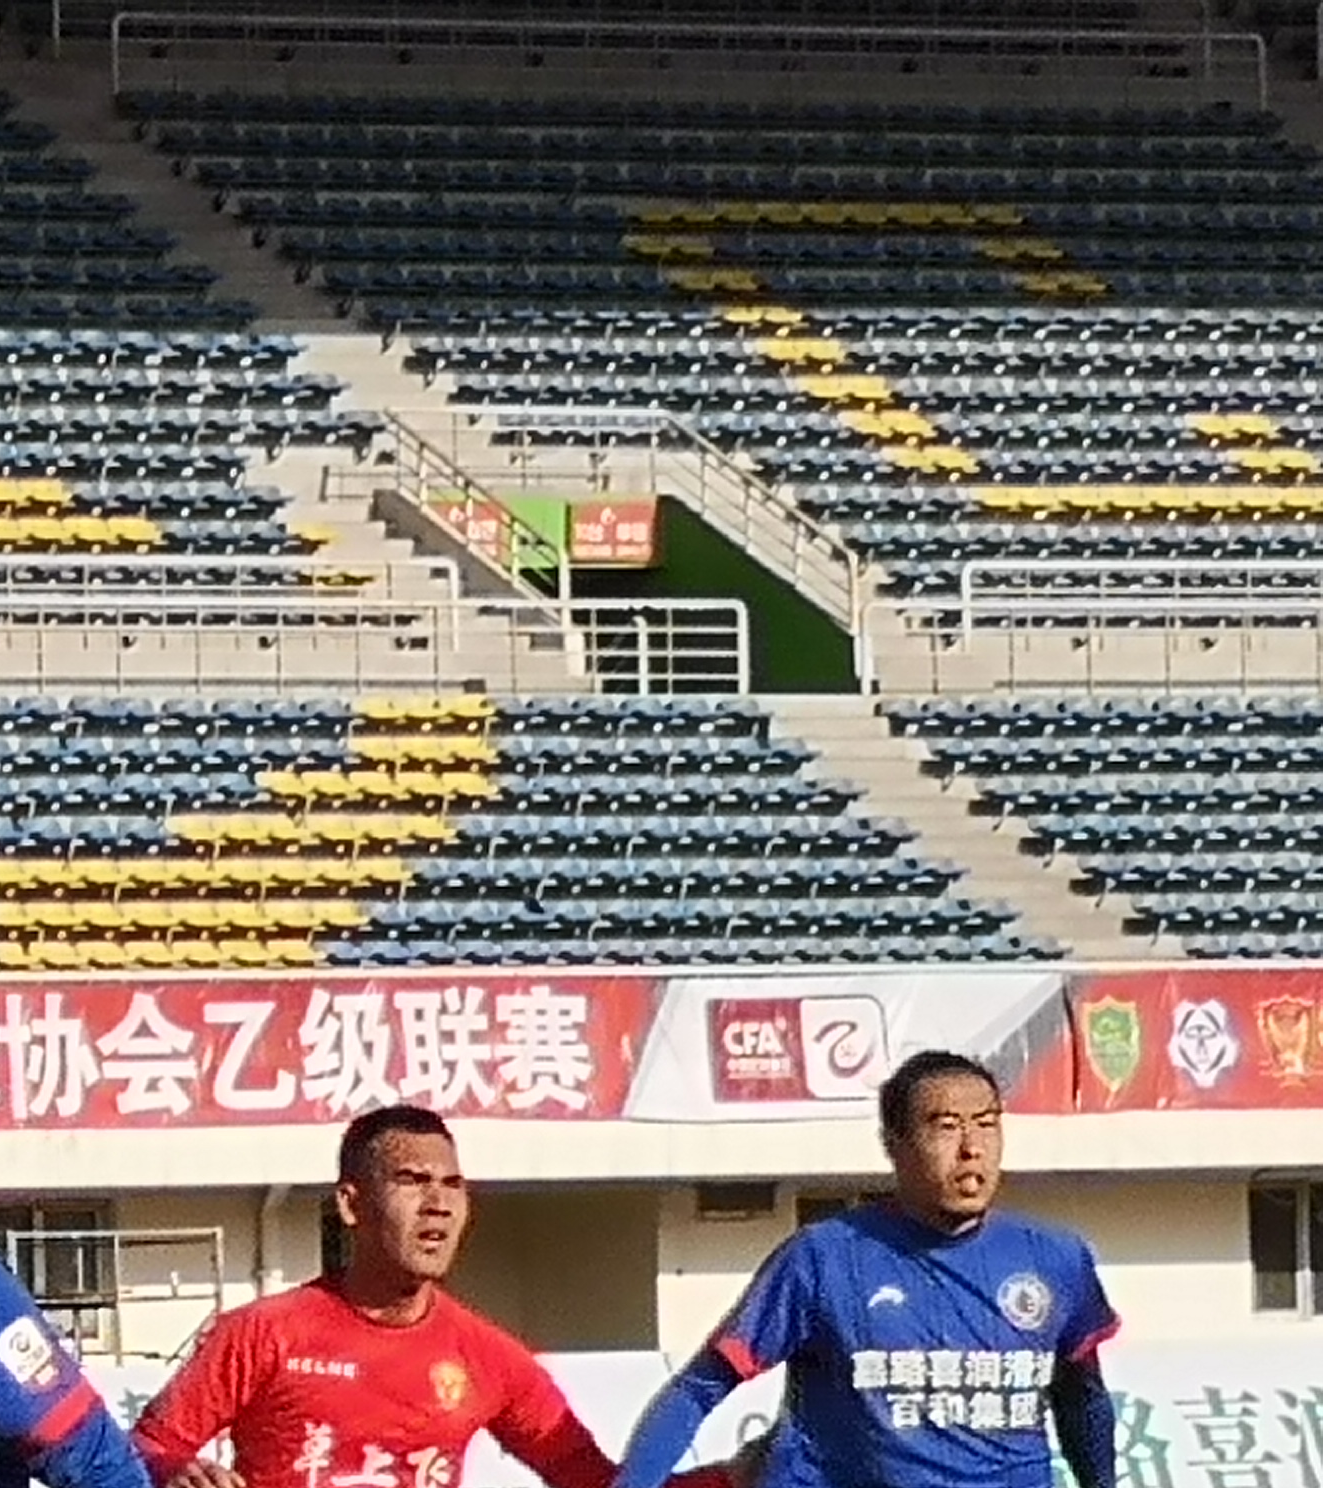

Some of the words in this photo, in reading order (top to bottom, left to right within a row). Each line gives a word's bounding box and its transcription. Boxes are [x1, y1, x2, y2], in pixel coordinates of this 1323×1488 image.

[723, 1021, 784, 1057] CFA
[886, 1391, 1039, 1428] 百和集团
